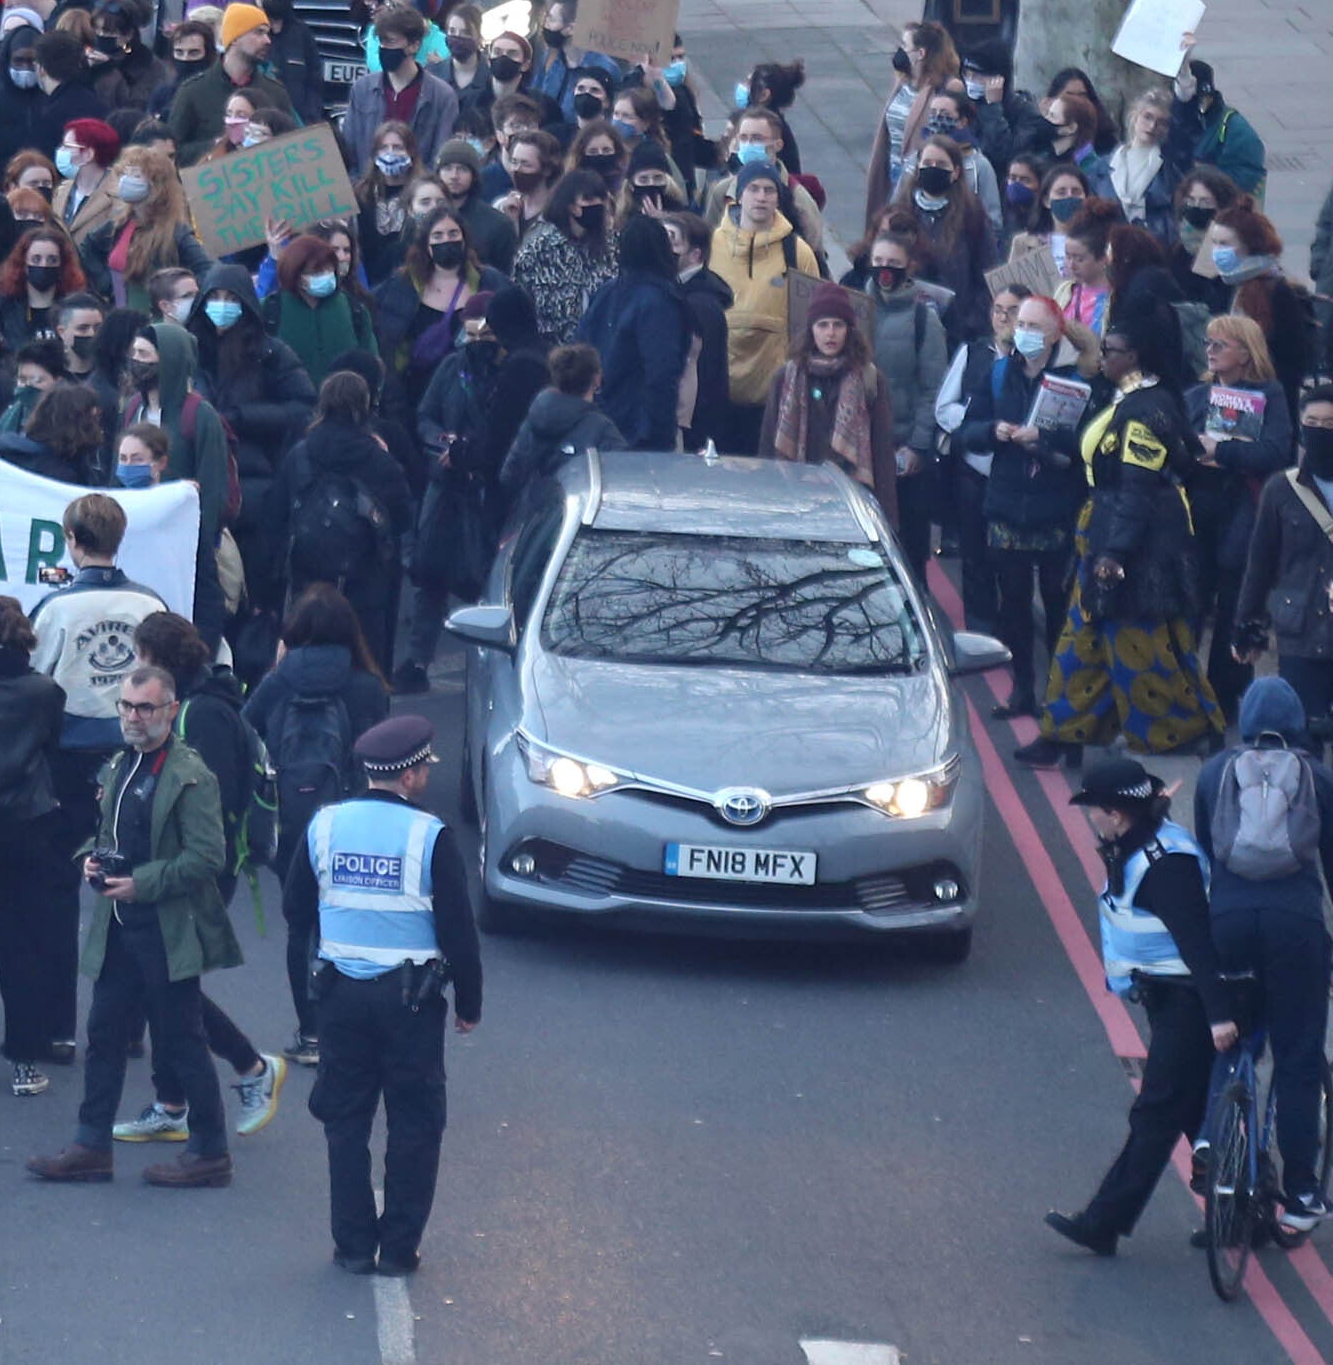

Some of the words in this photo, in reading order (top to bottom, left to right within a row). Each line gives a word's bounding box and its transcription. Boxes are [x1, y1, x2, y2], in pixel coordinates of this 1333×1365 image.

[197, 137, 327, 201] SISTERS
[212, 185, 264, 224] SAY
[270, 167, 338, 203] KILL
[217, 215, 267, 245] THE
[333, 853, 401, 876] POLICE
[688, 847, 747, 875] FN18
[753, 852, 806, 879] MFX
[334, 874, 364, 886] LIAISON
[364, 877, 401, 888] OFFICER
